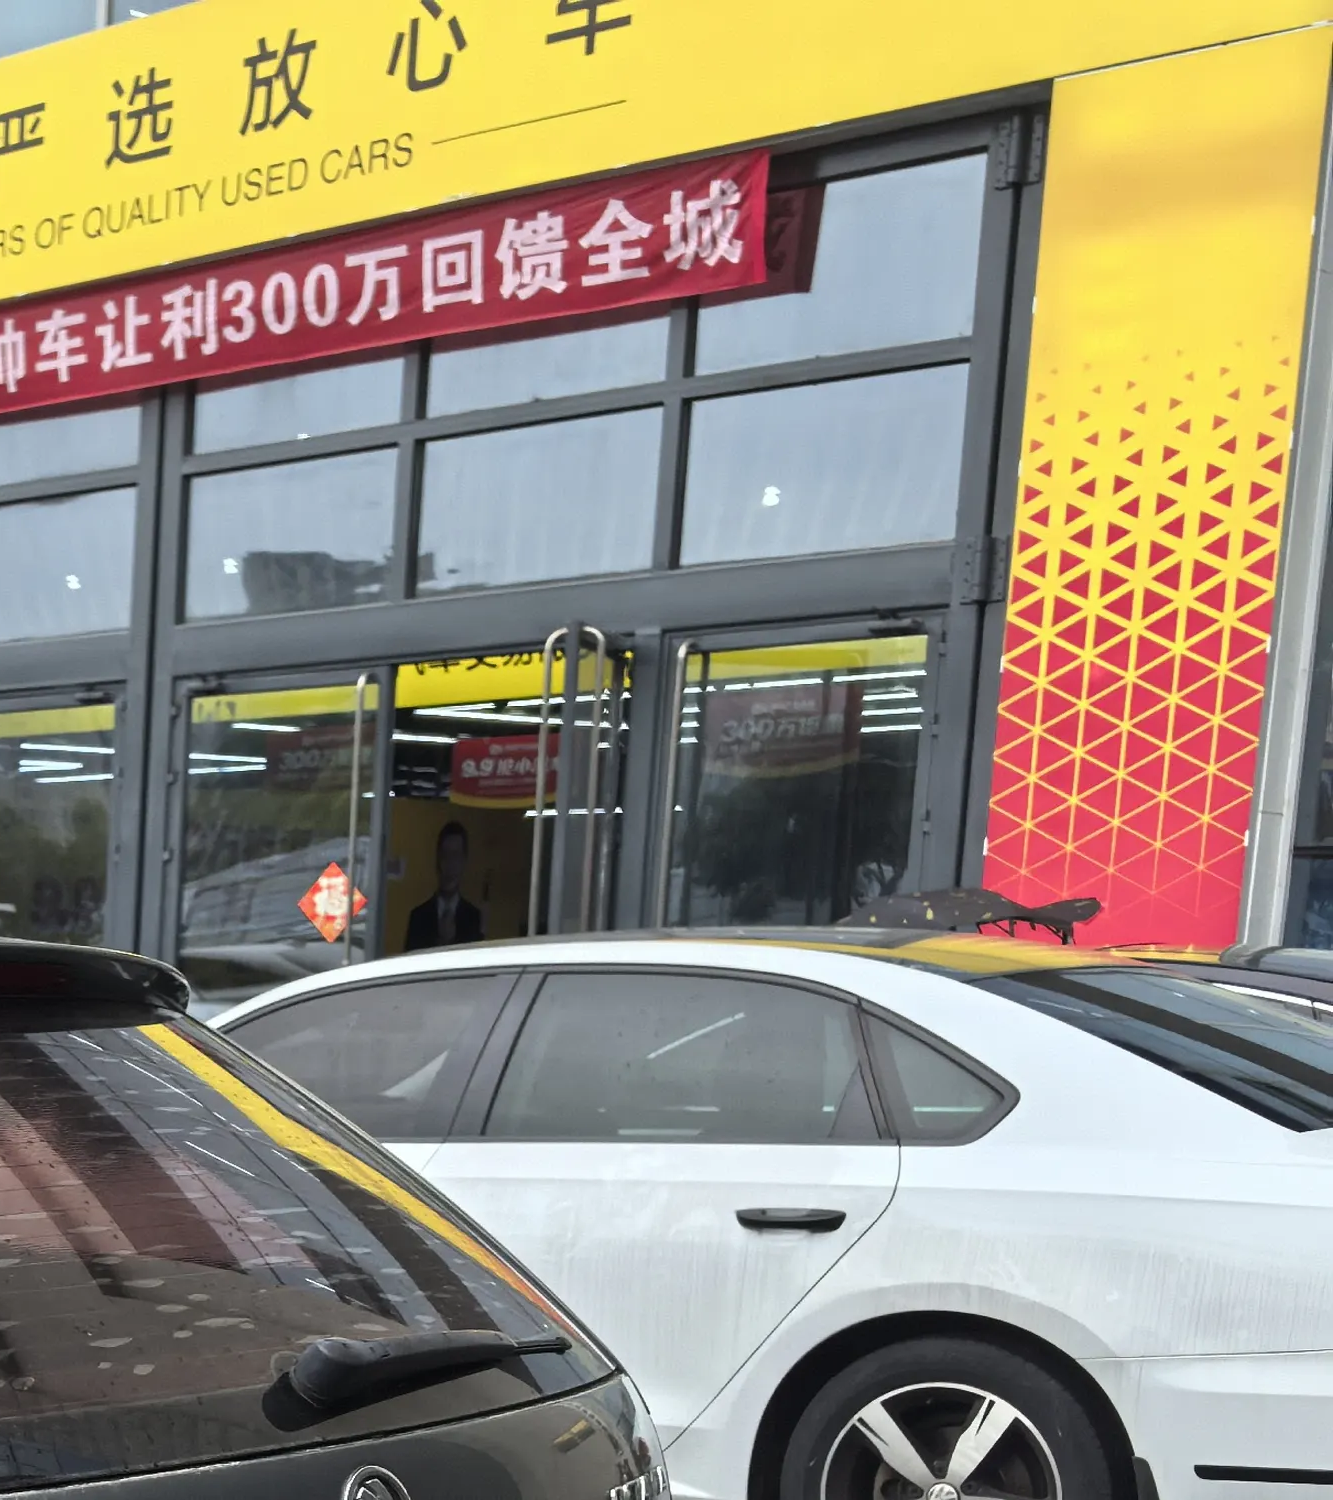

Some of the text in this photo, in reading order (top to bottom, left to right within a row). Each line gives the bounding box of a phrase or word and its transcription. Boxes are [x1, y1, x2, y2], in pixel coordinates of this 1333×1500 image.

[34, 212, 76, 250] OF
[81, 180, 212, 240] QUALITY
[220, 157, 309, 207] USED
[319, 132, 415, 185] CARS
